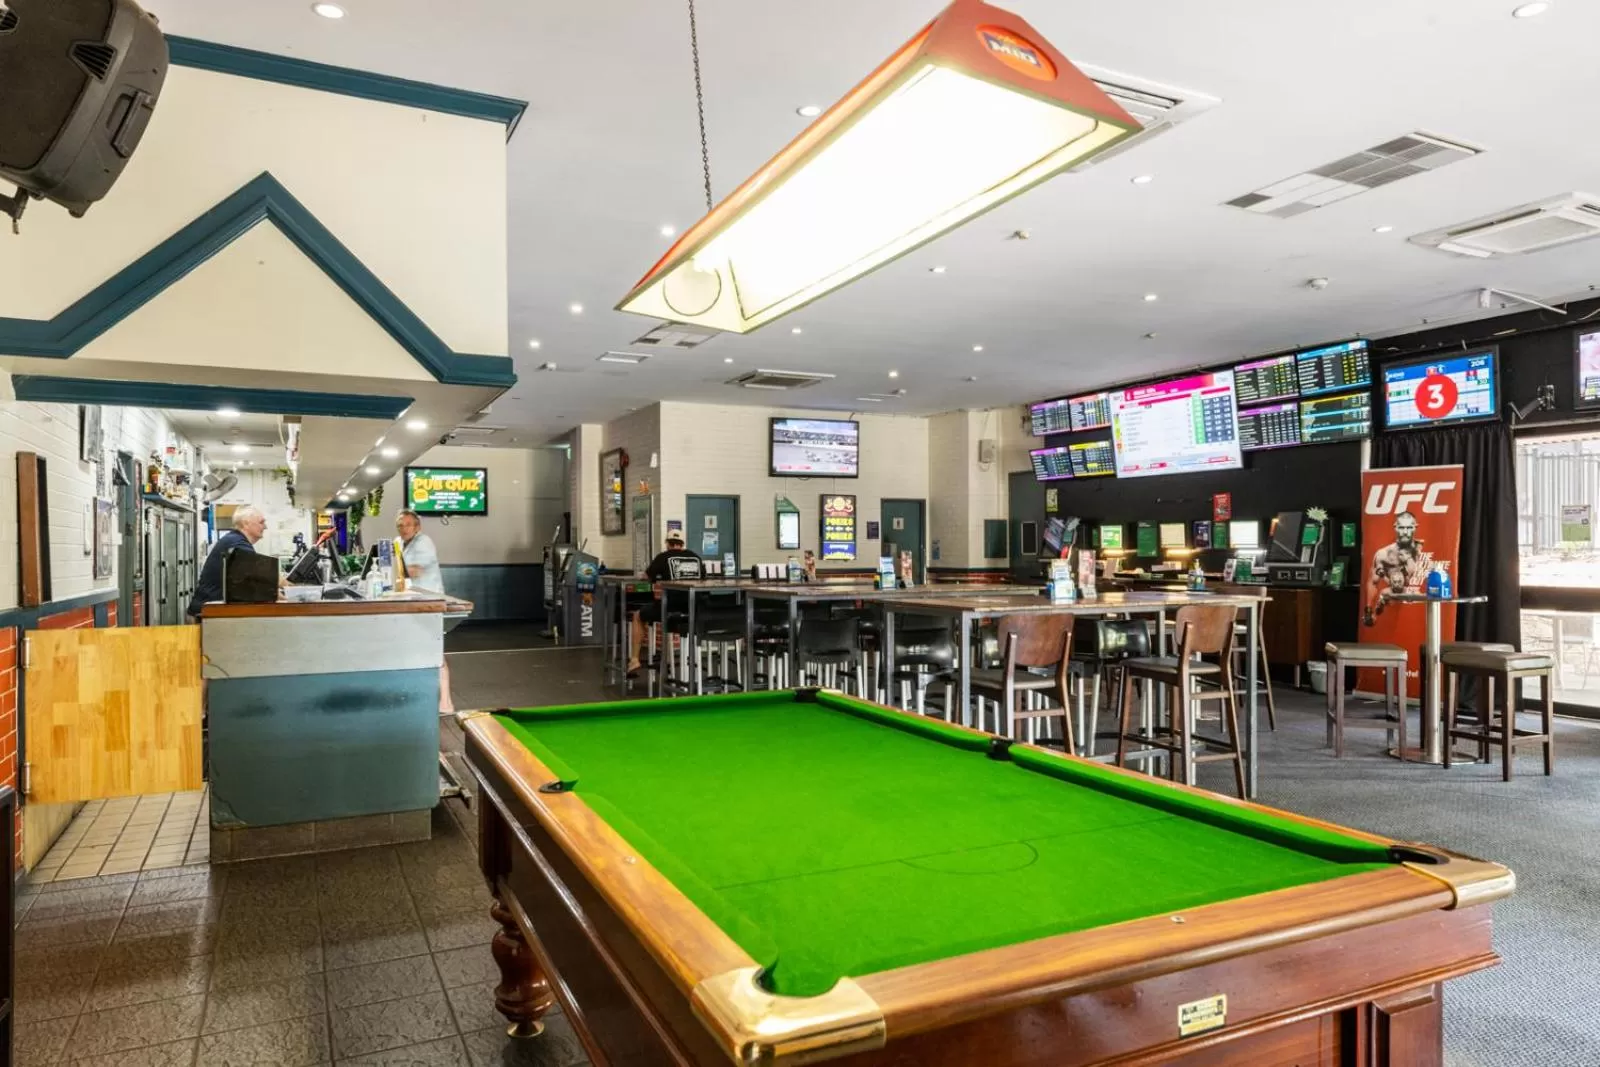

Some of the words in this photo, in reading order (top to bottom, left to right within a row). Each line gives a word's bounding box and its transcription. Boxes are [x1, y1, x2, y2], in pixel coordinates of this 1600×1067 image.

[1427, 384, 1445, 409] 3
[414, 477, 443, 490] PUB
[445, 477, 479, 491] QUIZ
[1364, 481, 1456, 515] UFC
[581, 604, 593, 637] ATM
